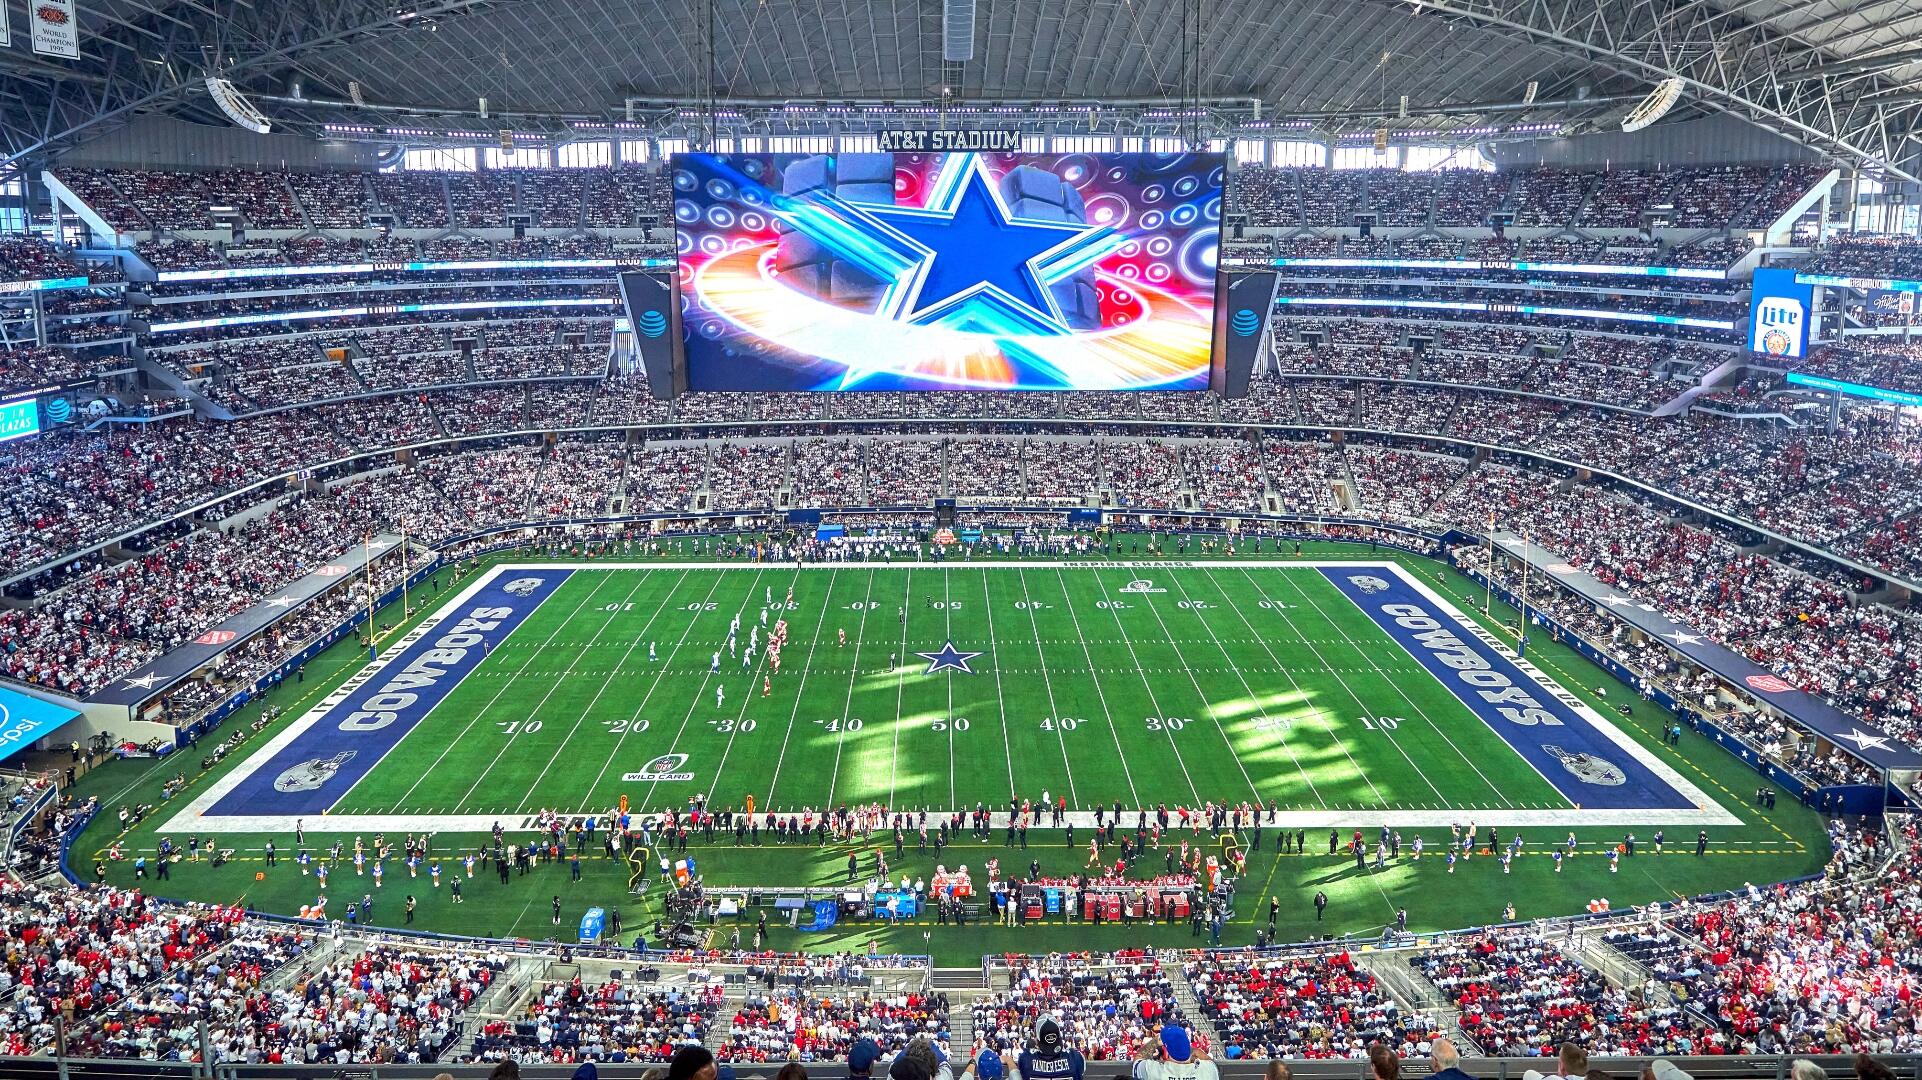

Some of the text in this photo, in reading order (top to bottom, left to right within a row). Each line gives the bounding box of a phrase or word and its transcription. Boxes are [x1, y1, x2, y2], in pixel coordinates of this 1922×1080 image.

[42, 28, 67, 38] WORLD
[35, 35, 75, 47] CHAMPIONS
[49, 45, 64, 53] 1995
[879, 131, 1020, 149] AT&T STADIUM
[374, 263, 401, 271] LOUD
[1762, 306, 1797, 326] Lite
[0, 419, 31, 433] LAZAS
[606, 602, 636, 611] 10
[688, 602, 718, 611] 20
[770, 601, 799, 610] 30
[852, 601, 880, 610] 40
[933, 601, 962, 610] 50
[1015, 601, 1044, 609] 40
[1096, 601, 1125, 609] 30
[1177, 601, 1208, 609] 20
[1258, 600, 1289, 609] 10
[311, 618, 441, 712] IT TAKES ALL OF US
[1381, 604, 1565, 726] COWBOYS
[1452, 614, 1585, 708] IT TAKES ALL OF US
[338, 606, 513, 731] COWBOYS
[501, 720, 543, 734] 10
[607, 719, 650, 733] 20
[717, 719, 757, 733] 30
[824, 718, 863, 731] 40
[931, 718, 970, 731] 50
[1039, 718, 1077, 731] 40
[1145, 717, 1184, 730] 30
[1251, 717, 1291, 730] 20
[1358, 717, 1397, 730] 10
